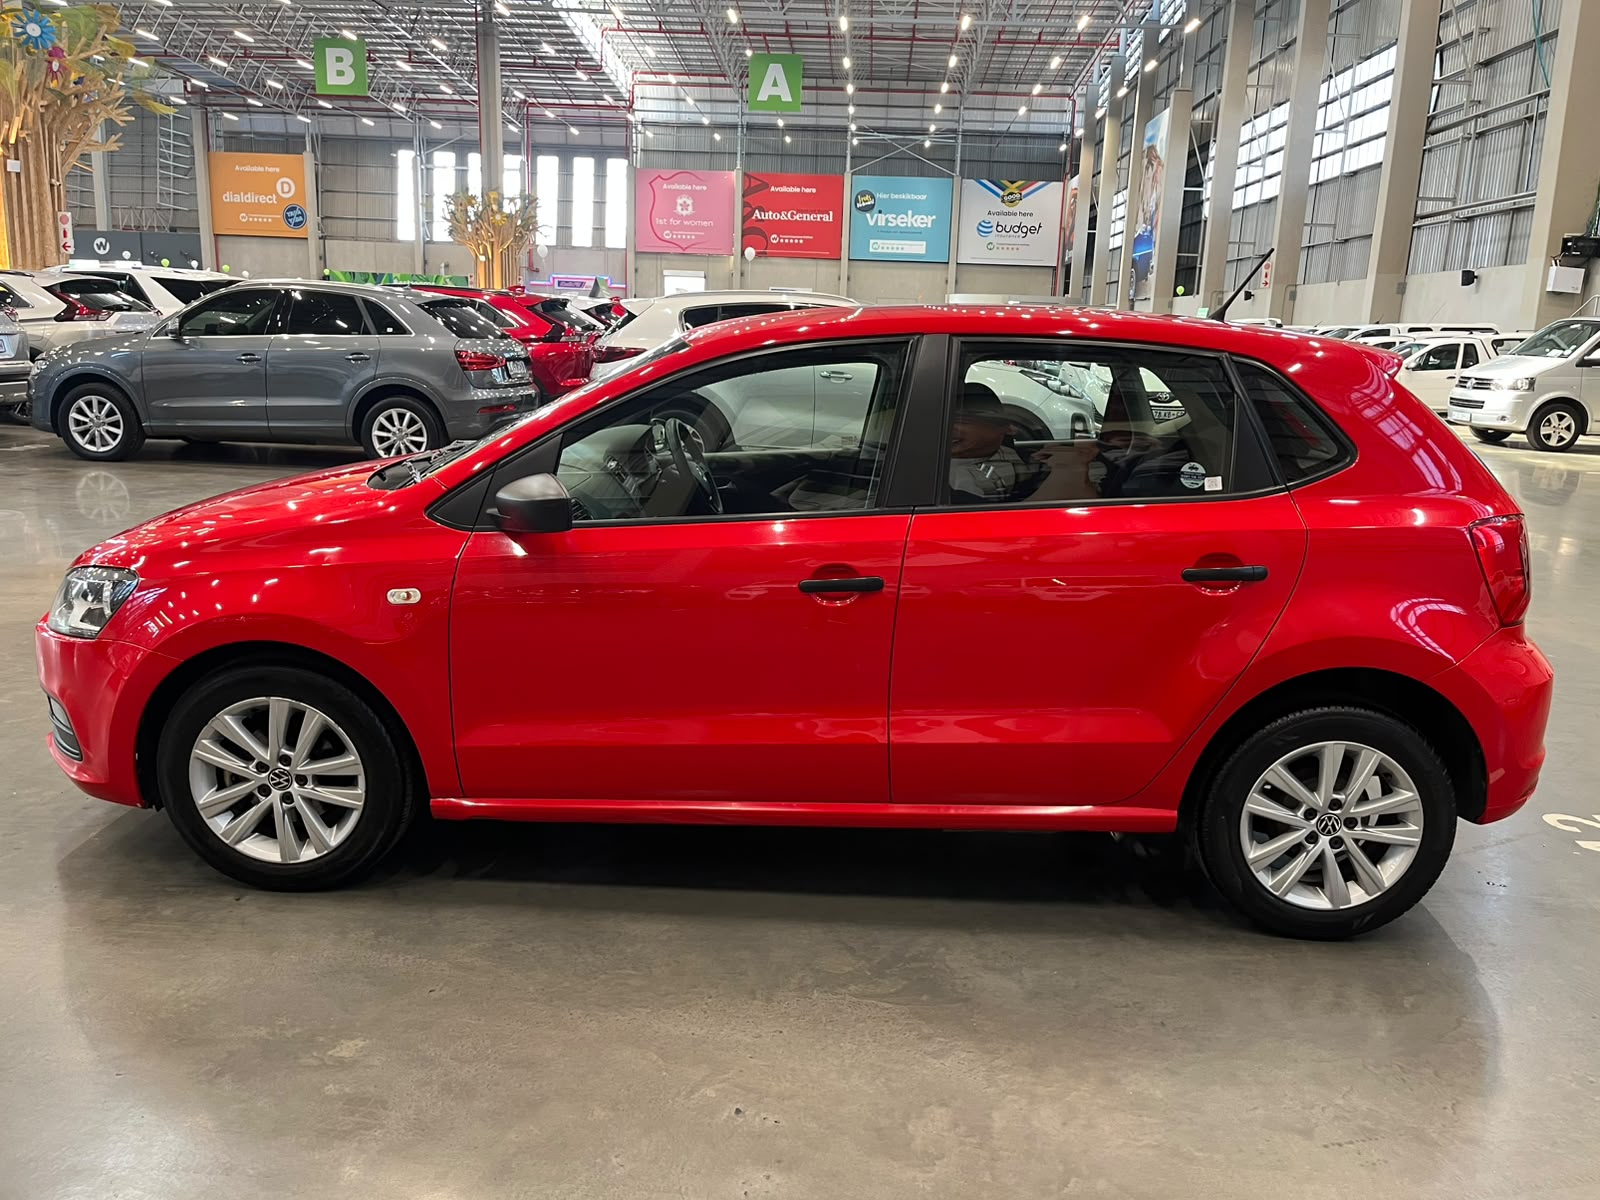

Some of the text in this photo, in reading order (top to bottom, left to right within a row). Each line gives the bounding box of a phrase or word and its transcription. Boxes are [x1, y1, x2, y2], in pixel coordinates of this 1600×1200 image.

[325, 47, 356, 86] B
[756, 63, 793, 102] A
[235, 164, 265, 172] Available
[770, 185, 801, 193] Available
[222, 191, 277, 204] dialdirect
[655, 217, 714, 228] 1st for women
[752, 208, 834, 223] Auto&General
[865, 209, 937, 228] virseker
[995, 220, 1043, 239] budget
